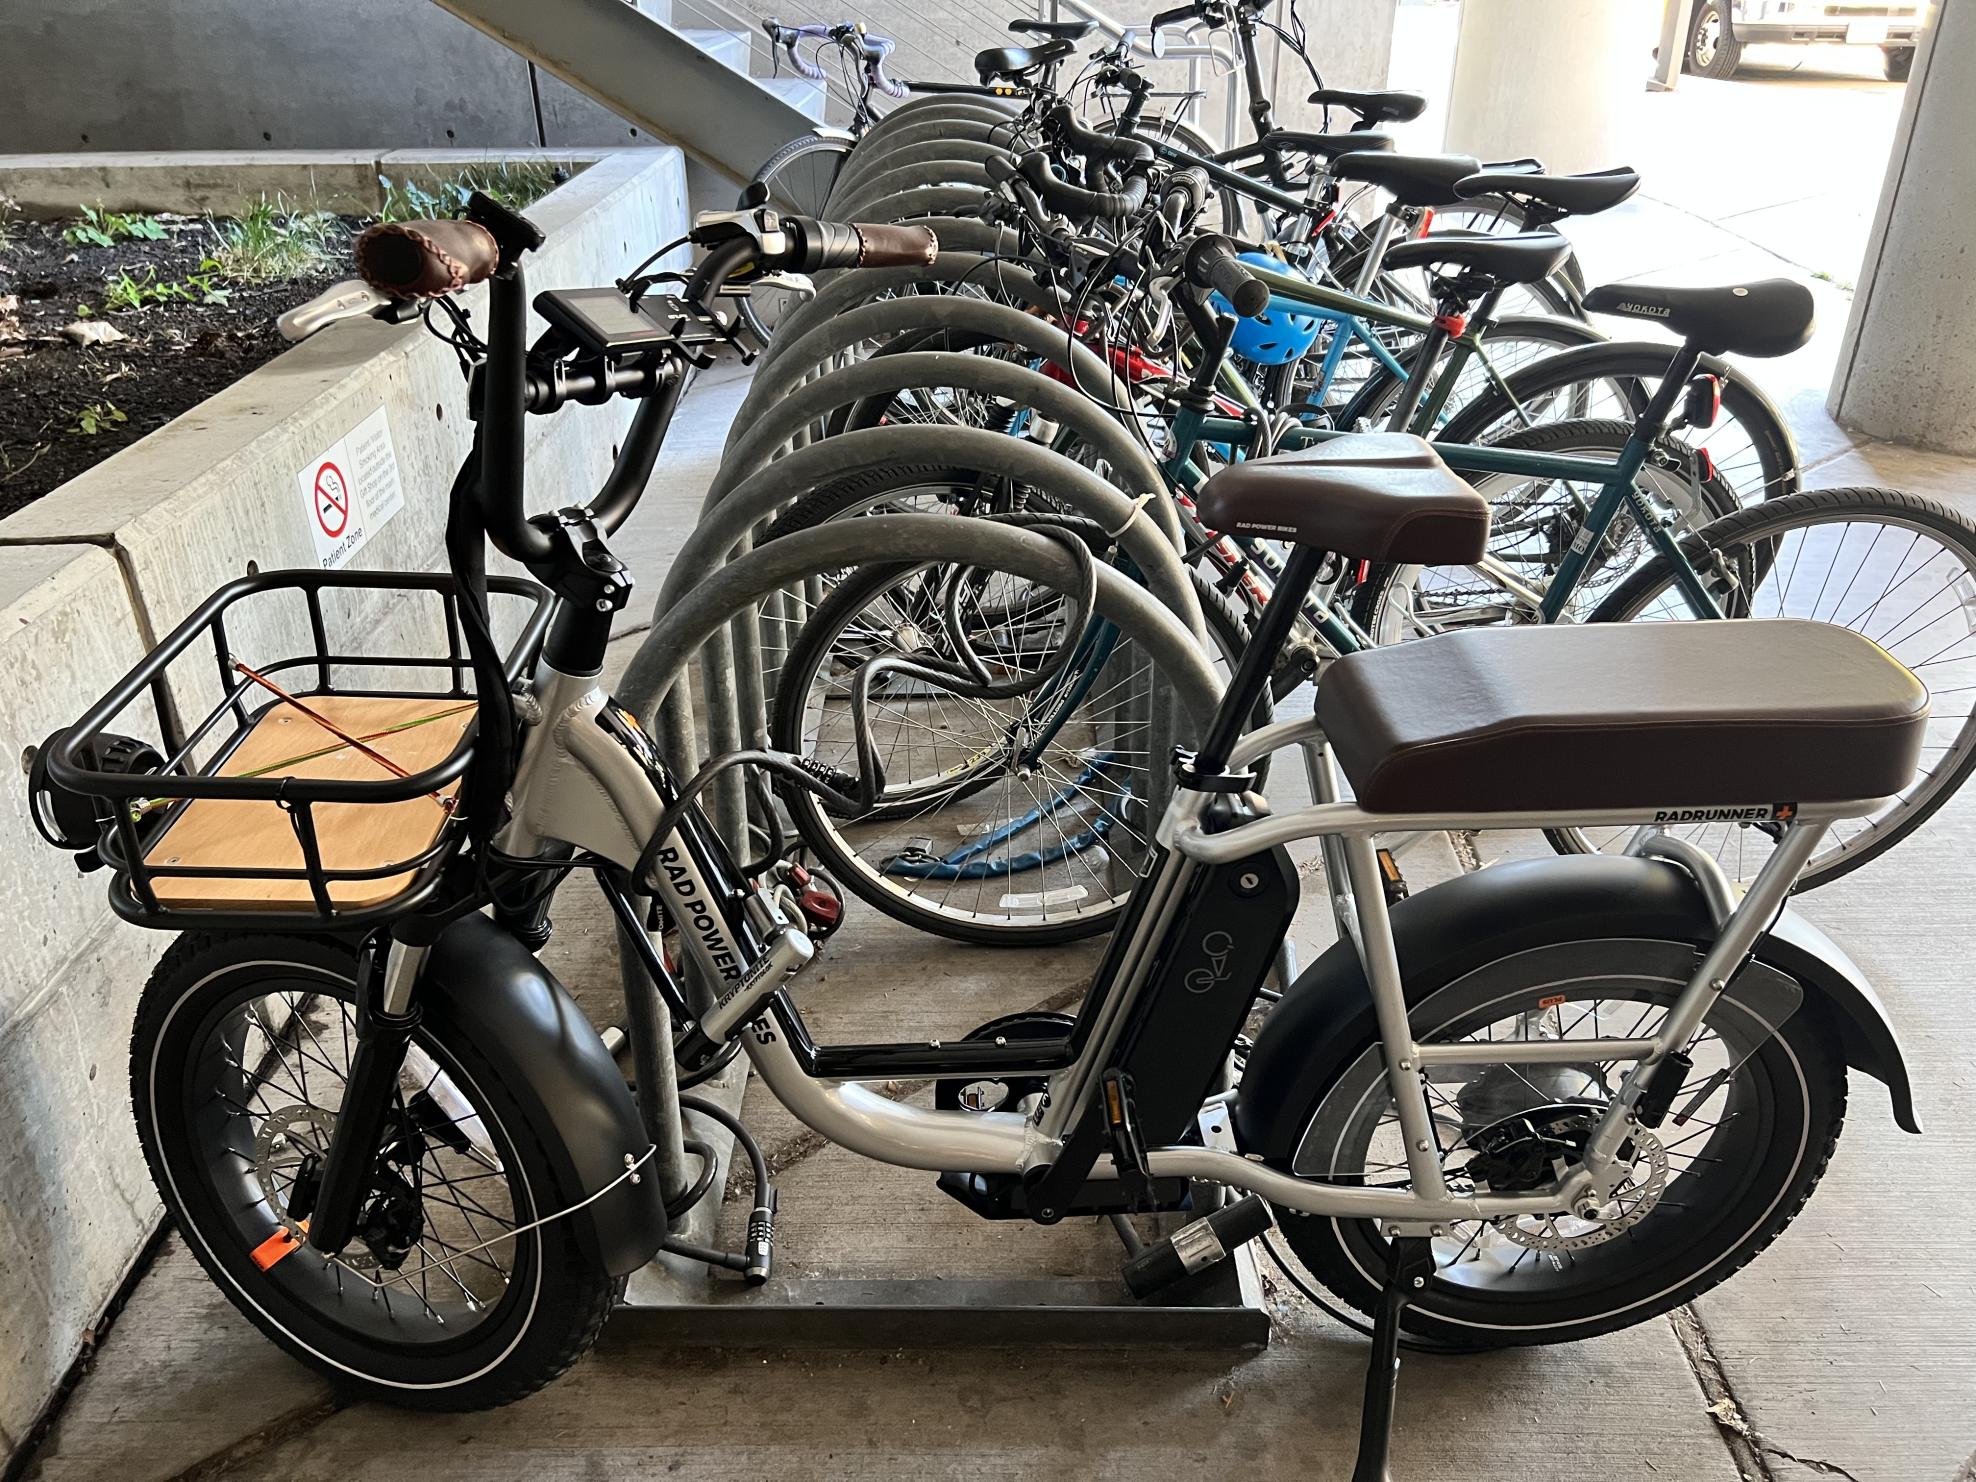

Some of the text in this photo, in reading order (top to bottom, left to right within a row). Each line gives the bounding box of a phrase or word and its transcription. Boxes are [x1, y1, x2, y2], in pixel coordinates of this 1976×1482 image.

[1251, 522, 1277, 531] POWER
[322, 527, 363, 569] Patient Zone
[1654, 808, 1768, 822] RADRUNNER
[657, 846, 777, 1045] RAD POWER ES
[718, 956, 770, 1010] KRYPTONITE
